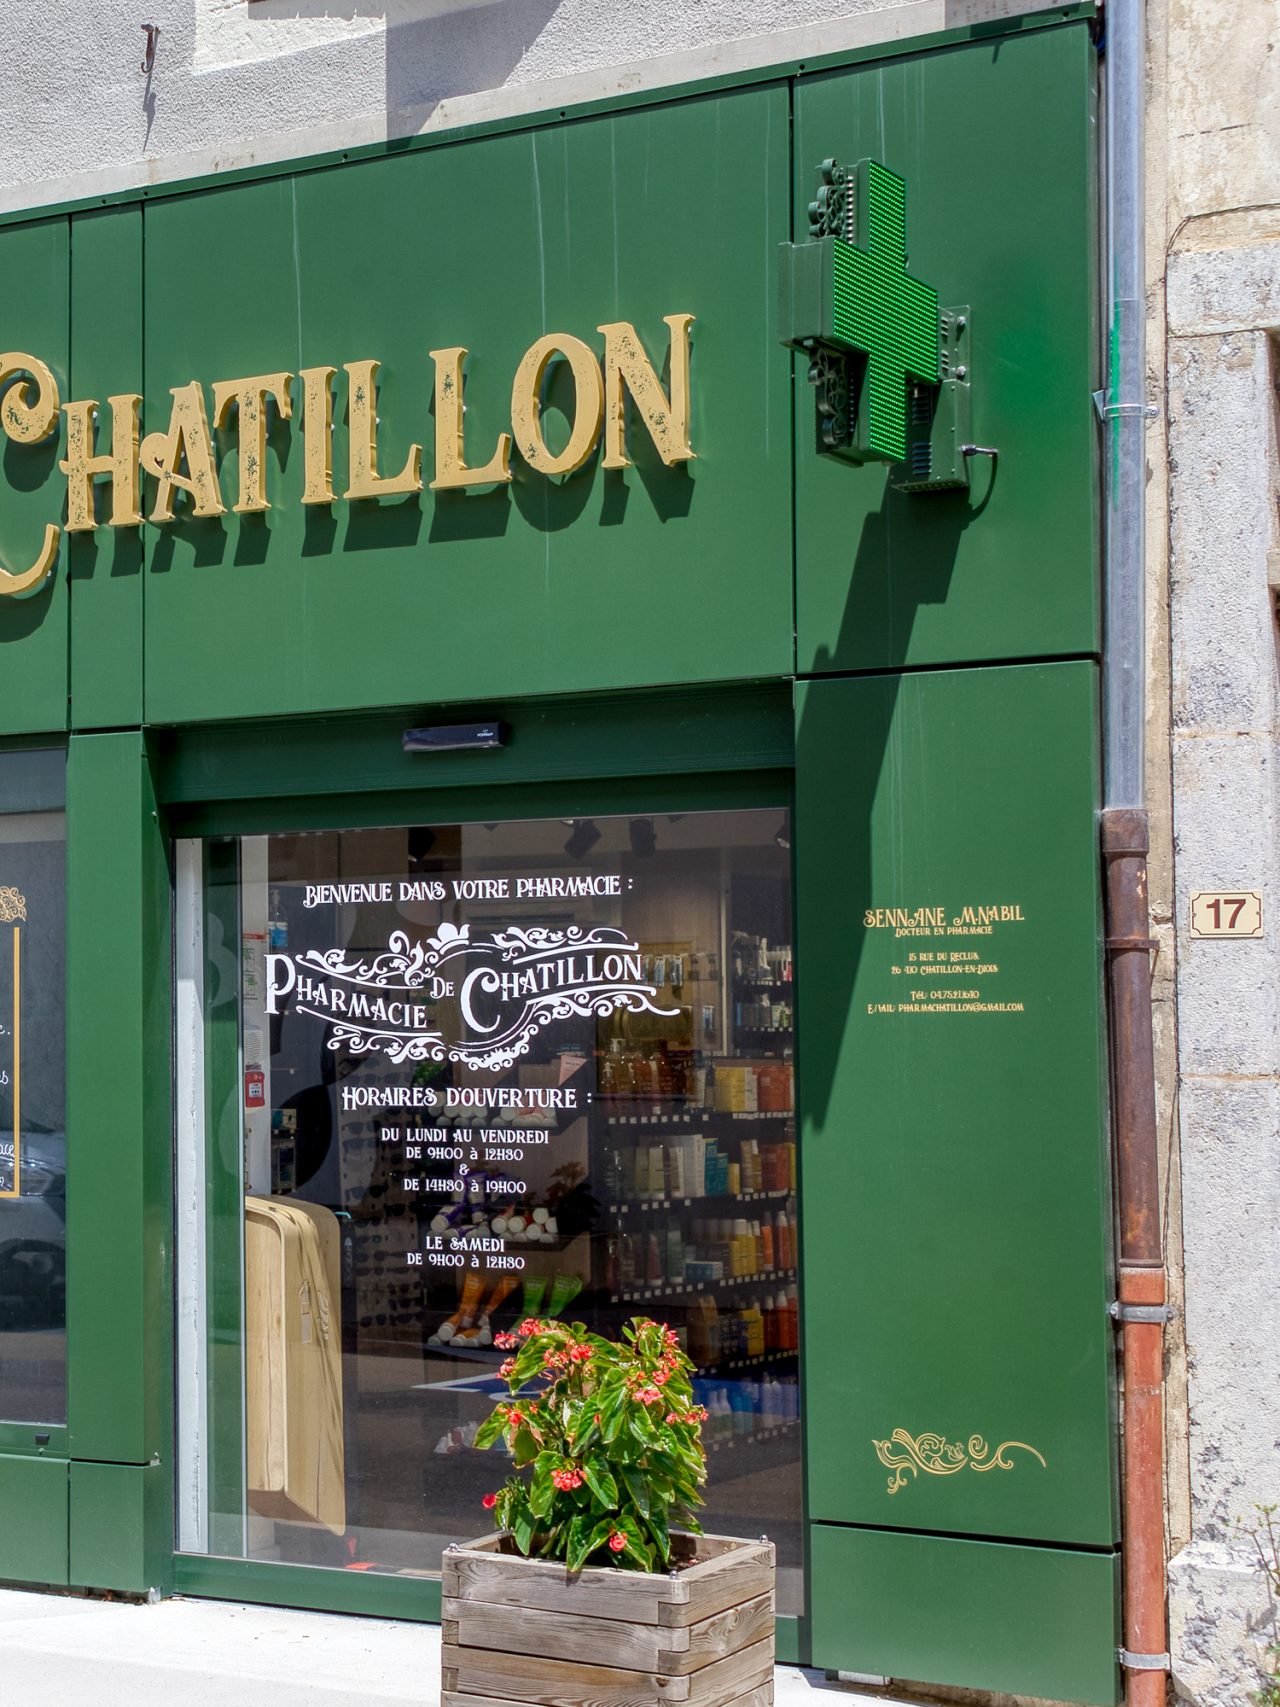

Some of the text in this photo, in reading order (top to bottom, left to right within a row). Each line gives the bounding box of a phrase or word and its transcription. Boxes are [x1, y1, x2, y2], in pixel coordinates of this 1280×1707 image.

[303, 883, 393, 908] BIENVENUE
[399, 881, 446, 901] DANS
[451, 878, 510, 899] VOTRE
[516, 875, 621, 898] PHARMACIE
[863, 907, 946, 928] SENNANE
[1206, 899, 1246, 929] 17
[895, 926, 993, 938] DOCTEUR EN PHARMACIE
[919, 952, 934, 961] RUE
[937, 952, 947, 961] DU
[950, 952, 979, 962] RECLUS
[263, 953, 643, 1033] PHARMACIE DE CHATILLON
[342, 1086, 438, 1110] HORAIRES
[446, 1086, 577, 1109] D'OUVERTURE
[381, 1128, 549, 1144] DU LUNDI AU VENDREDI
[406, 1147, 524, 1161] DE 9H00 à 12H30
[459, 1163, 470, 1175] &
[403, 1179, 527, 1194] DE 14H30 à 19H00
[426, 1236, 504, 1252] LE SAMEDI
[407, 1253, 525, 1270] DE 9H00 à 12H30
